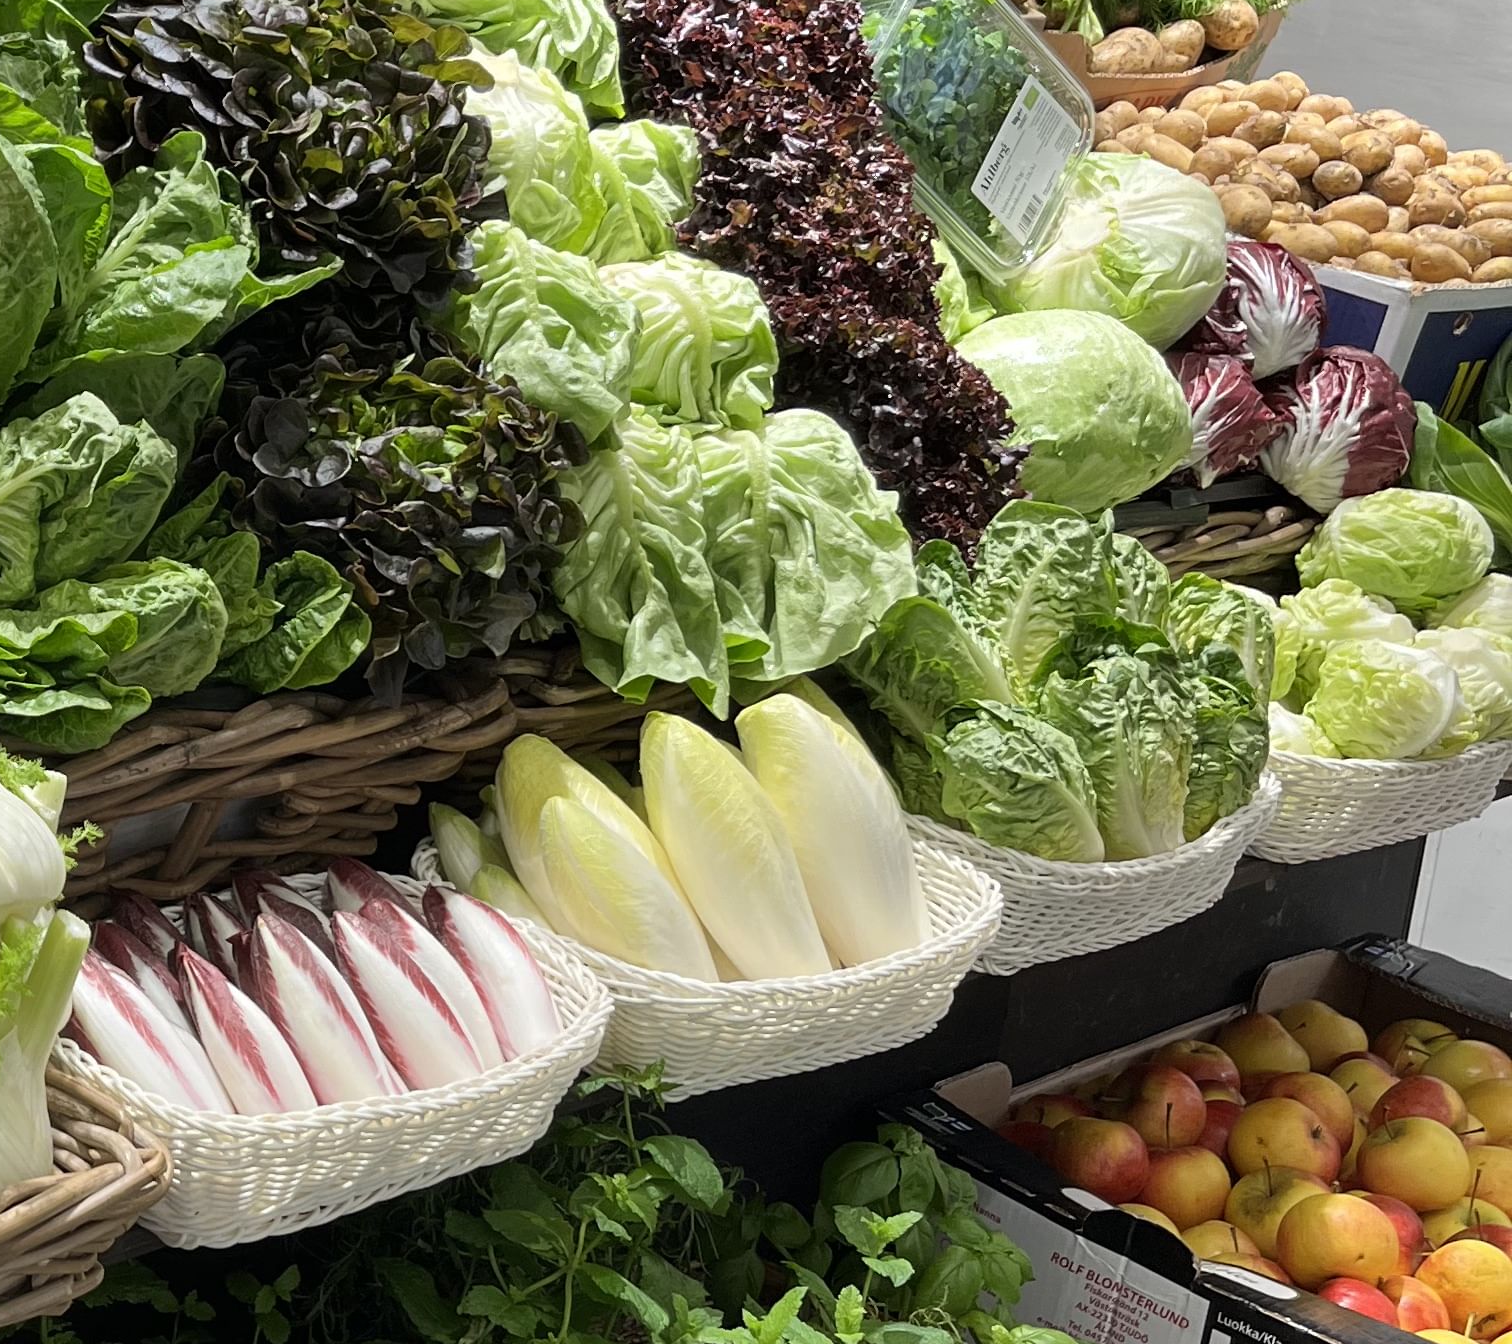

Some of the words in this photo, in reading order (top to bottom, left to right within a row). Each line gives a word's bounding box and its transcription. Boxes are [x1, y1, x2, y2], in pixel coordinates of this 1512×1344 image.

[1050, 1251, 1085, 1276] ROLF
[1085, 1269, 1190, 1330] BLOMSTERLUND
[1138, 1309, 1150, 1322] 12
[1068, 1319, 1083, 1335] Tel.
